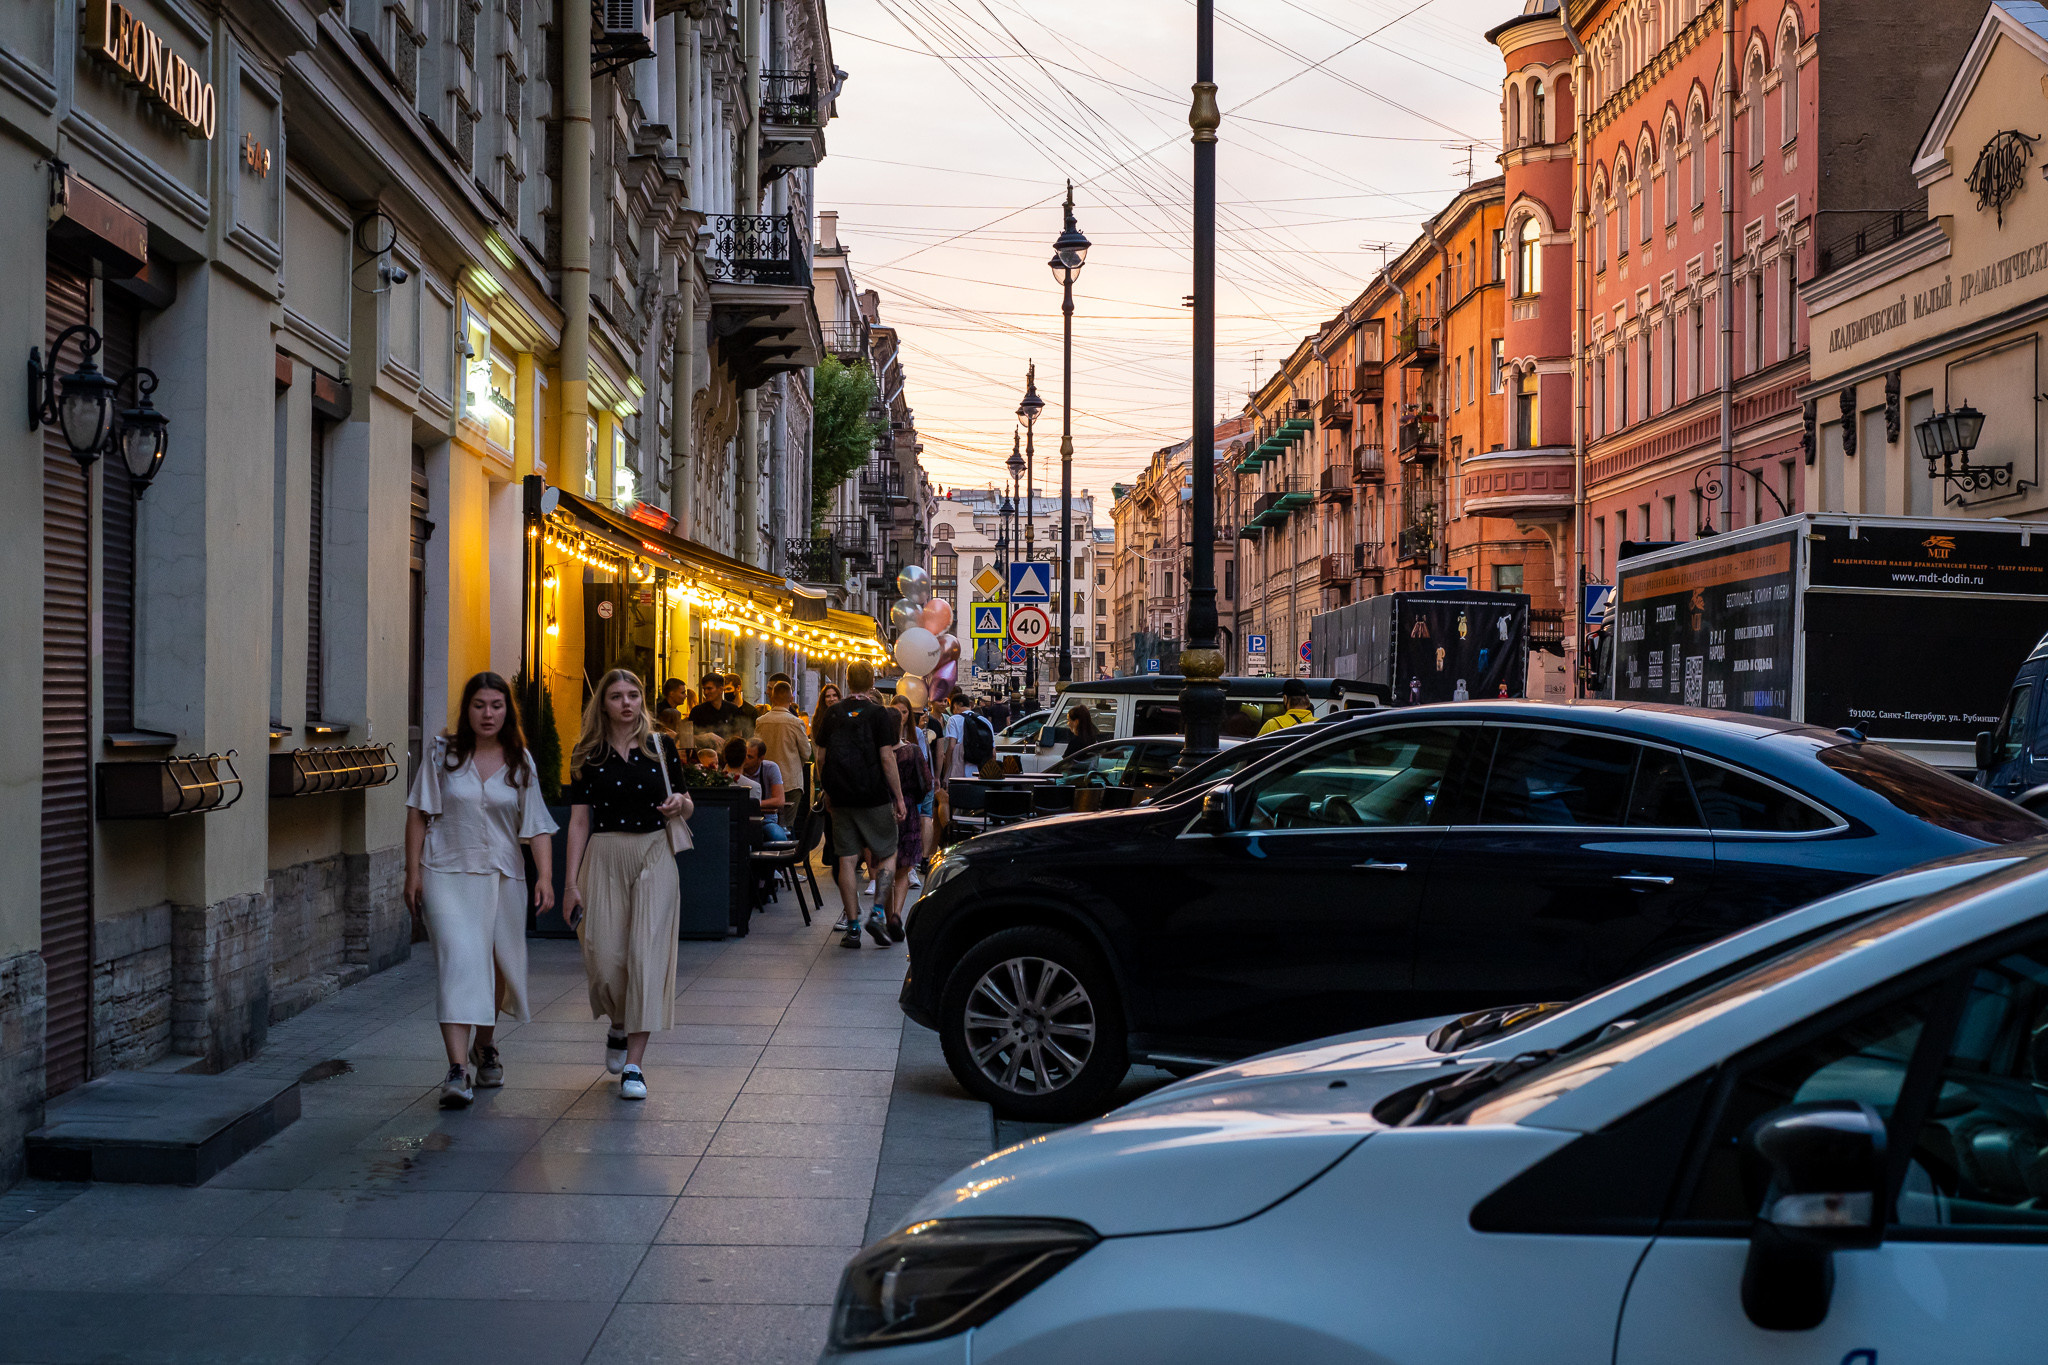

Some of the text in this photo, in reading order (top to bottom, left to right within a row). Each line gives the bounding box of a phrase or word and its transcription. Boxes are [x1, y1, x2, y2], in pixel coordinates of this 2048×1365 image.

[103, 0, 216, 141] LEONARDO
[1829, 293, 1907, 354] АКАДЕМИЧЕСКИЙ
[1913, 274, 1952, 320] МАЛЫЙ
[1832, 558, 1887, 566] АКАДЕМИЧЕСКИЙ
[1914, 561, 1967, 569] ДРАМАТИЧЕСКИЙ
[1891, 572, 1984, 585] www.mdt-dodin.ru
[1656, 604, 1677, 623] ГАМЛЕТ
[1017, 618, 1040, 635] 40
[1849, 708, 1878, 719] 191002,
[1879, 710, 1947, 723] Санкт-Петербург,
[1948, 714, 1961, 723] ул.
